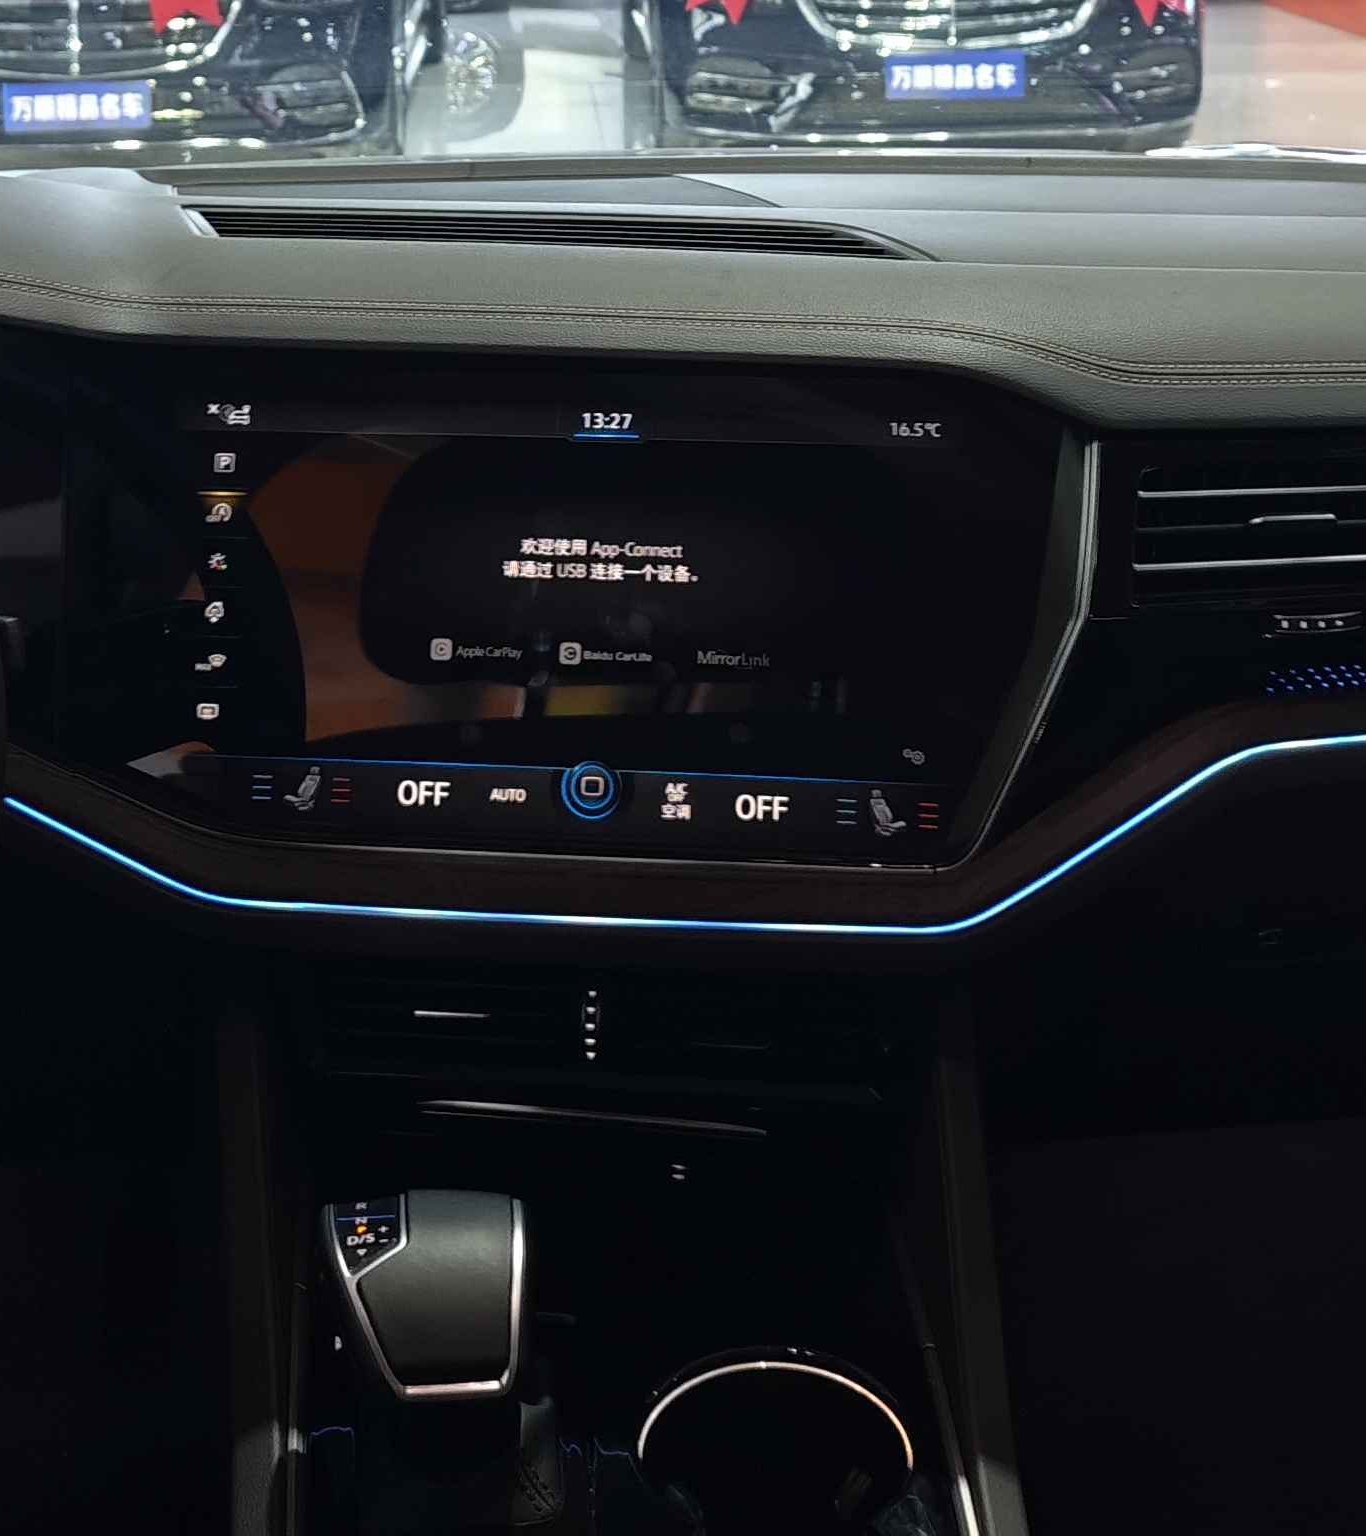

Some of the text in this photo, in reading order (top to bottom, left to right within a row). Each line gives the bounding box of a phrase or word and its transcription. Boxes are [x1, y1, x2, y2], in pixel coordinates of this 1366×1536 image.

[581, 412, 633, 431] 13:27
[519, 538, 684, 559] 欢迎使用 App-Connect
[501, 560, 554, 578] 请通过
[556, 562, 588, 578] USB
[455, 644, 523, 661] Apple CarPlay
[696, 649, 771, 667] MirrorLink
[396, 779, 452, 808] OFF
[488, 787, 528, 804] AUTO
[734, 793, 790, 823] OFF
[347, 1233, 375, 1246] D/S
